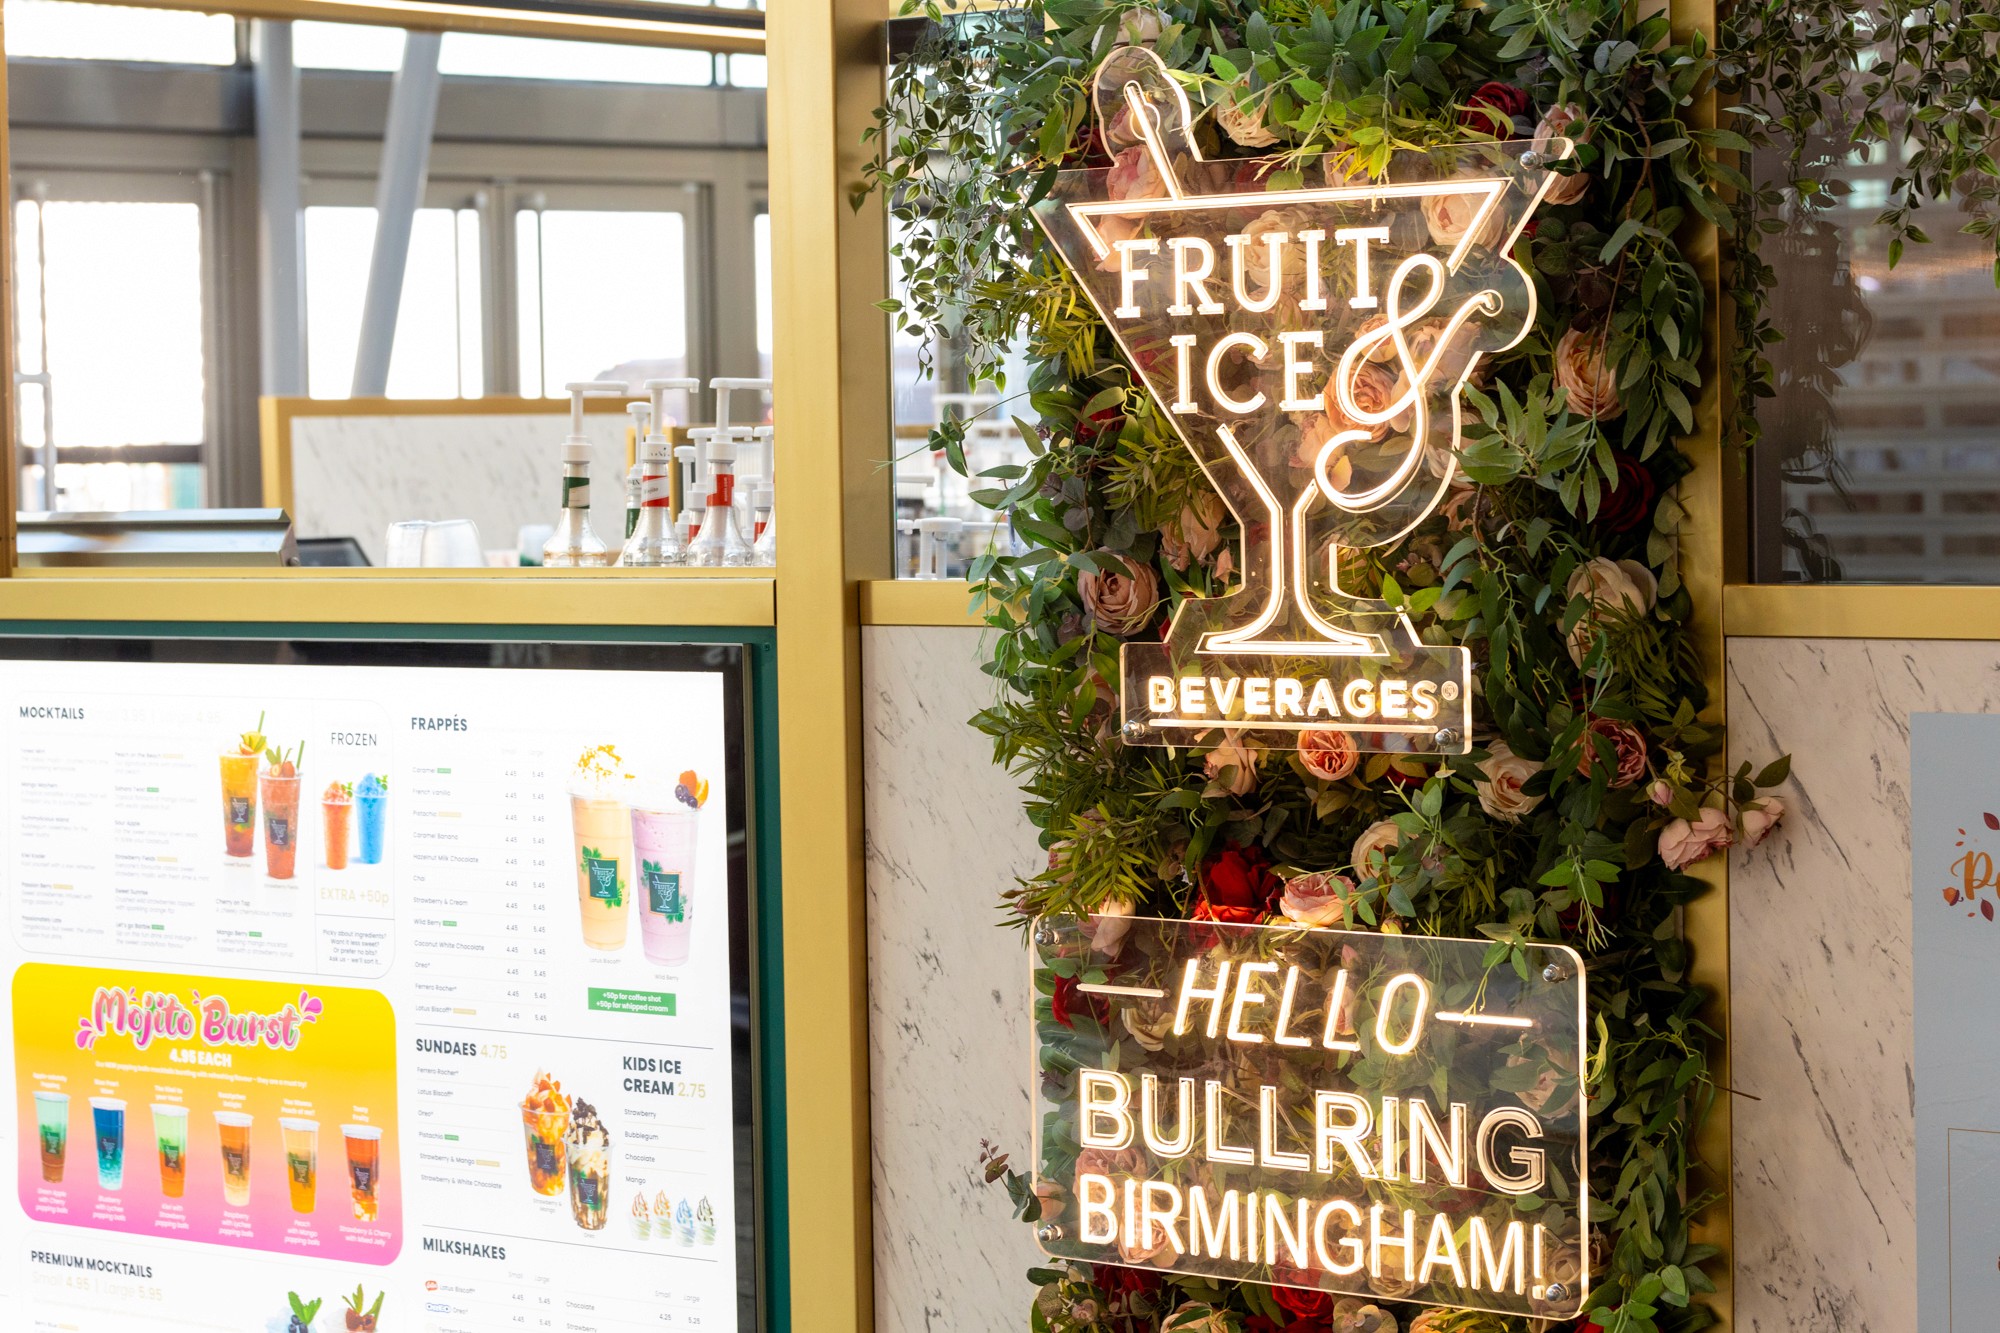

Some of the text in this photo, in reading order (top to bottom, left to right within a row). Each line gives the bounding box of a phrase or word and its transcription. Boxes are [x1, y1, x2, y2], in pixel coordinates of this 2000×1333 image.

[1113, 226, 1503, 513] FRUIT &
[1169, 330, 1325, 414] ICE
[20, 706, 84, 720] MOCKTAILS
[411, 714, 468, 731] FRAPPÉS
[330, 732, 377, 746] FROZEN
[320, 888, 390, 907] EXTRA +50p
[413, 897, 443, 905] Strawberry
[456, 942, 484, 951] Chocolate
[603, 992, 618, 1001] +50p
[597, 1000, 611, 1009] +50p
[622, 1002, 647, 1012] whipped
[1173, 958, 1429, 1055] HELLO
[95, 986, 301, 1050] Mojito Burst
[416, 1038, 508, 1059] SUNDAES 4.75
[169, 1048, 232, 1067] 4.95 EACH
[623, 1056, 682, 1074] KIDS ICE
[623, 1078, 706, 1099] CREAM 2.75
[624, 1108, 657, 1119] Strawberry
[419, 1131, 443, 1140] Pistachio
[624, 1130, 659, 1141] Bubblegum
[1080, 1067, 1546, 1196] BULLRING
[420, 1153, 449, 1162] Strawberry
[456, 1157, 475, 1165] Mango
[625, 1153, 656, 1163] Chocolate
[421, 1174, 450, 1184] Strawberry
[474, 1180, 502, 1189] Chocolate
[625, 1176, 646, 1185] Mango
[1079, 1173, 1547, 1301] BIRMINGHAM!
[423, 1237, 506, 1260] MILKSHAKES
[31, 1250, 153, 1279] PREMIUM MOCKTAILS
[508, 1271, 550, 1284] Small Large
[138, 1285, 164, 1302] 5.95
[655, 1290, 700, 1303] Small Large
[566, 1301, 595, 1311] Chocolate
[688, 1316, 700, 1324] 5.25
[539, 1319, 551, 1327] 5.45
[567, 1323, 597, 1333] Strawberry
